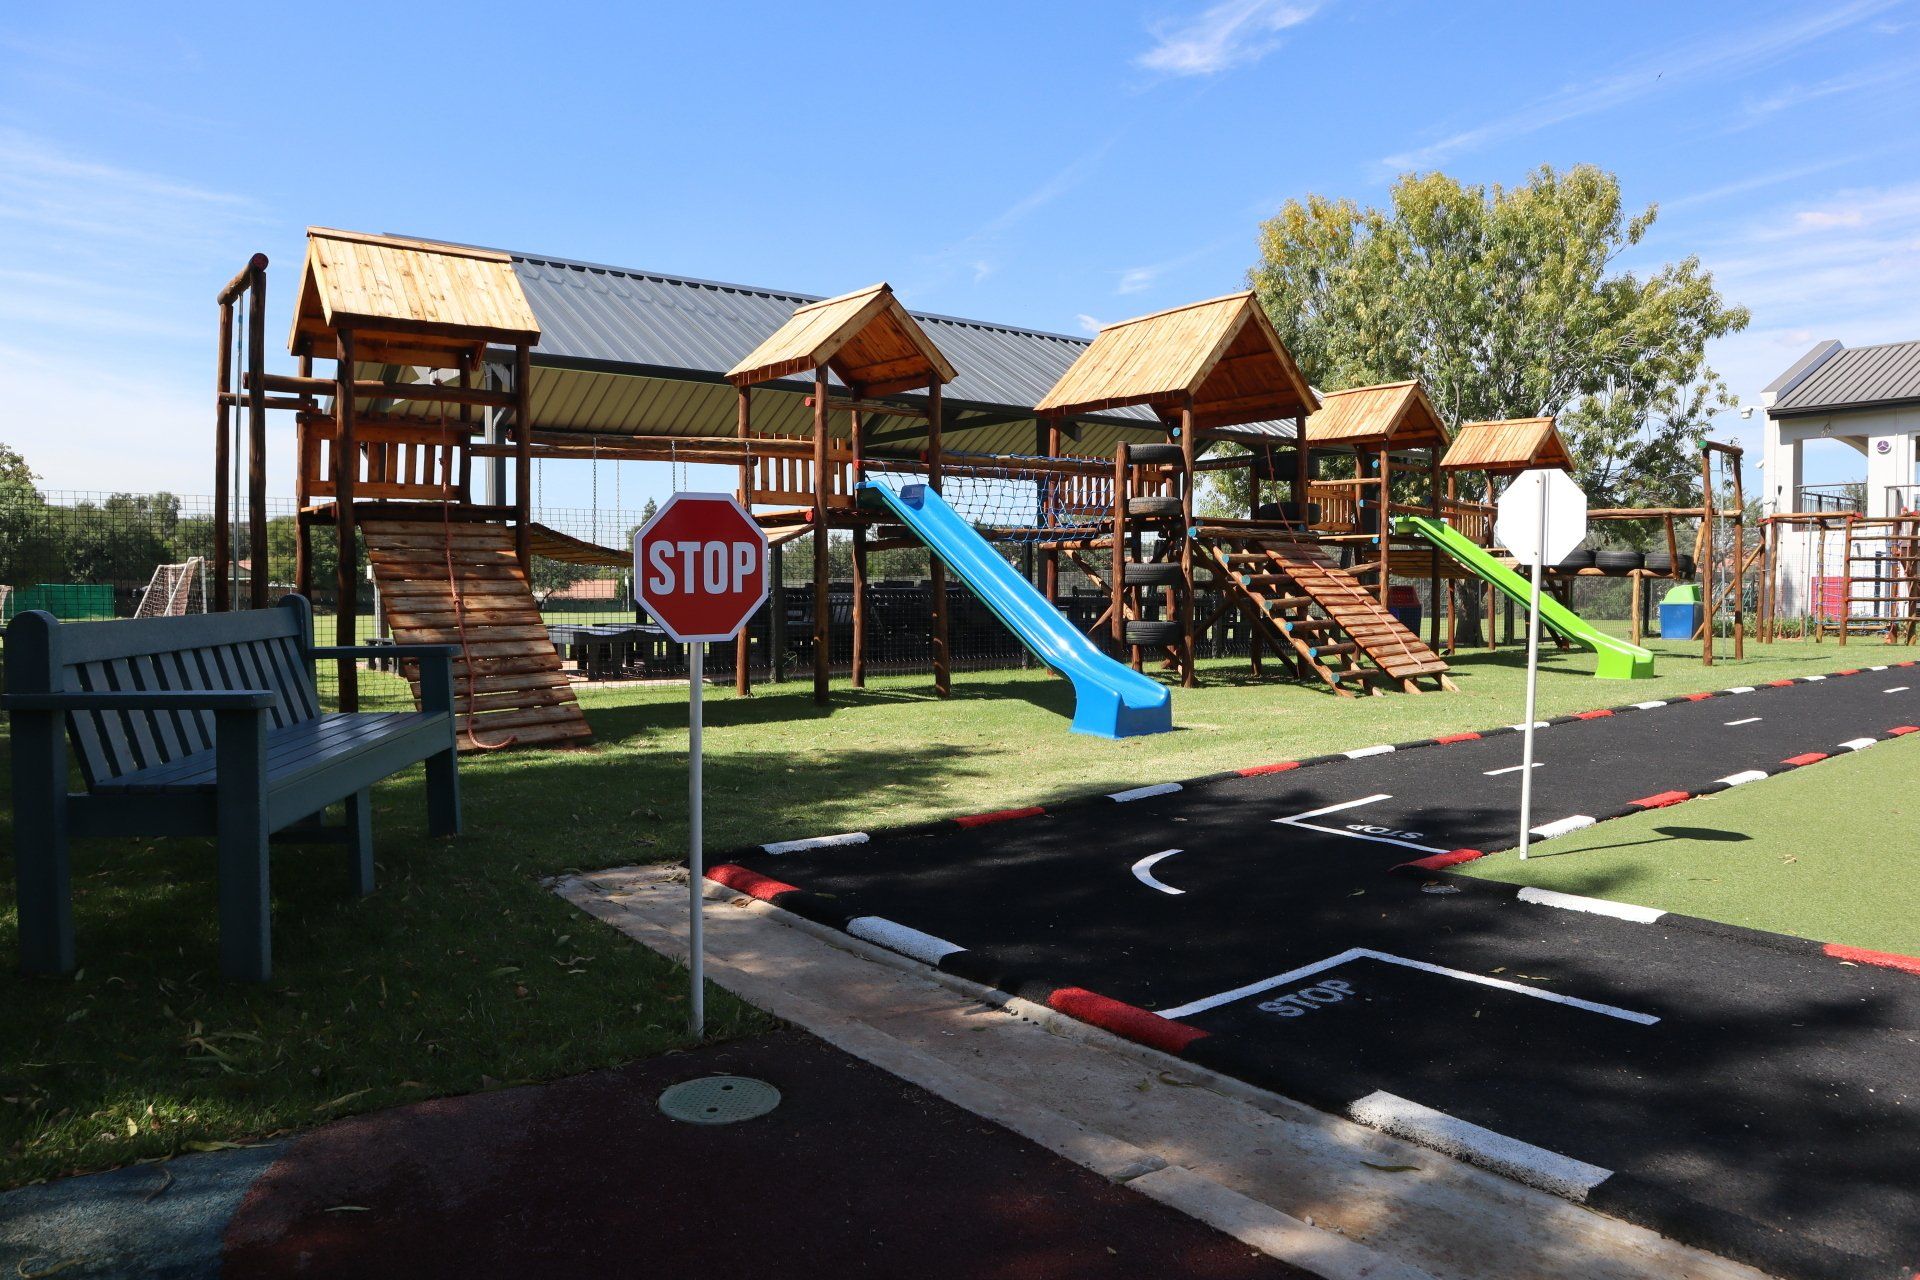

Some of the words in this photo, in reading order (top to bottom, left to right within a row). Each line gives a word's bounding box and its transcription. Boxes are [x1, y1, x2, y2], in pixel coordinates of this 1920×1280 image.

[650, 540, 756, 596] STOP
[1346, 824, 1424, 839] STOP
[1257, 979, 1356, 1017] STOP
